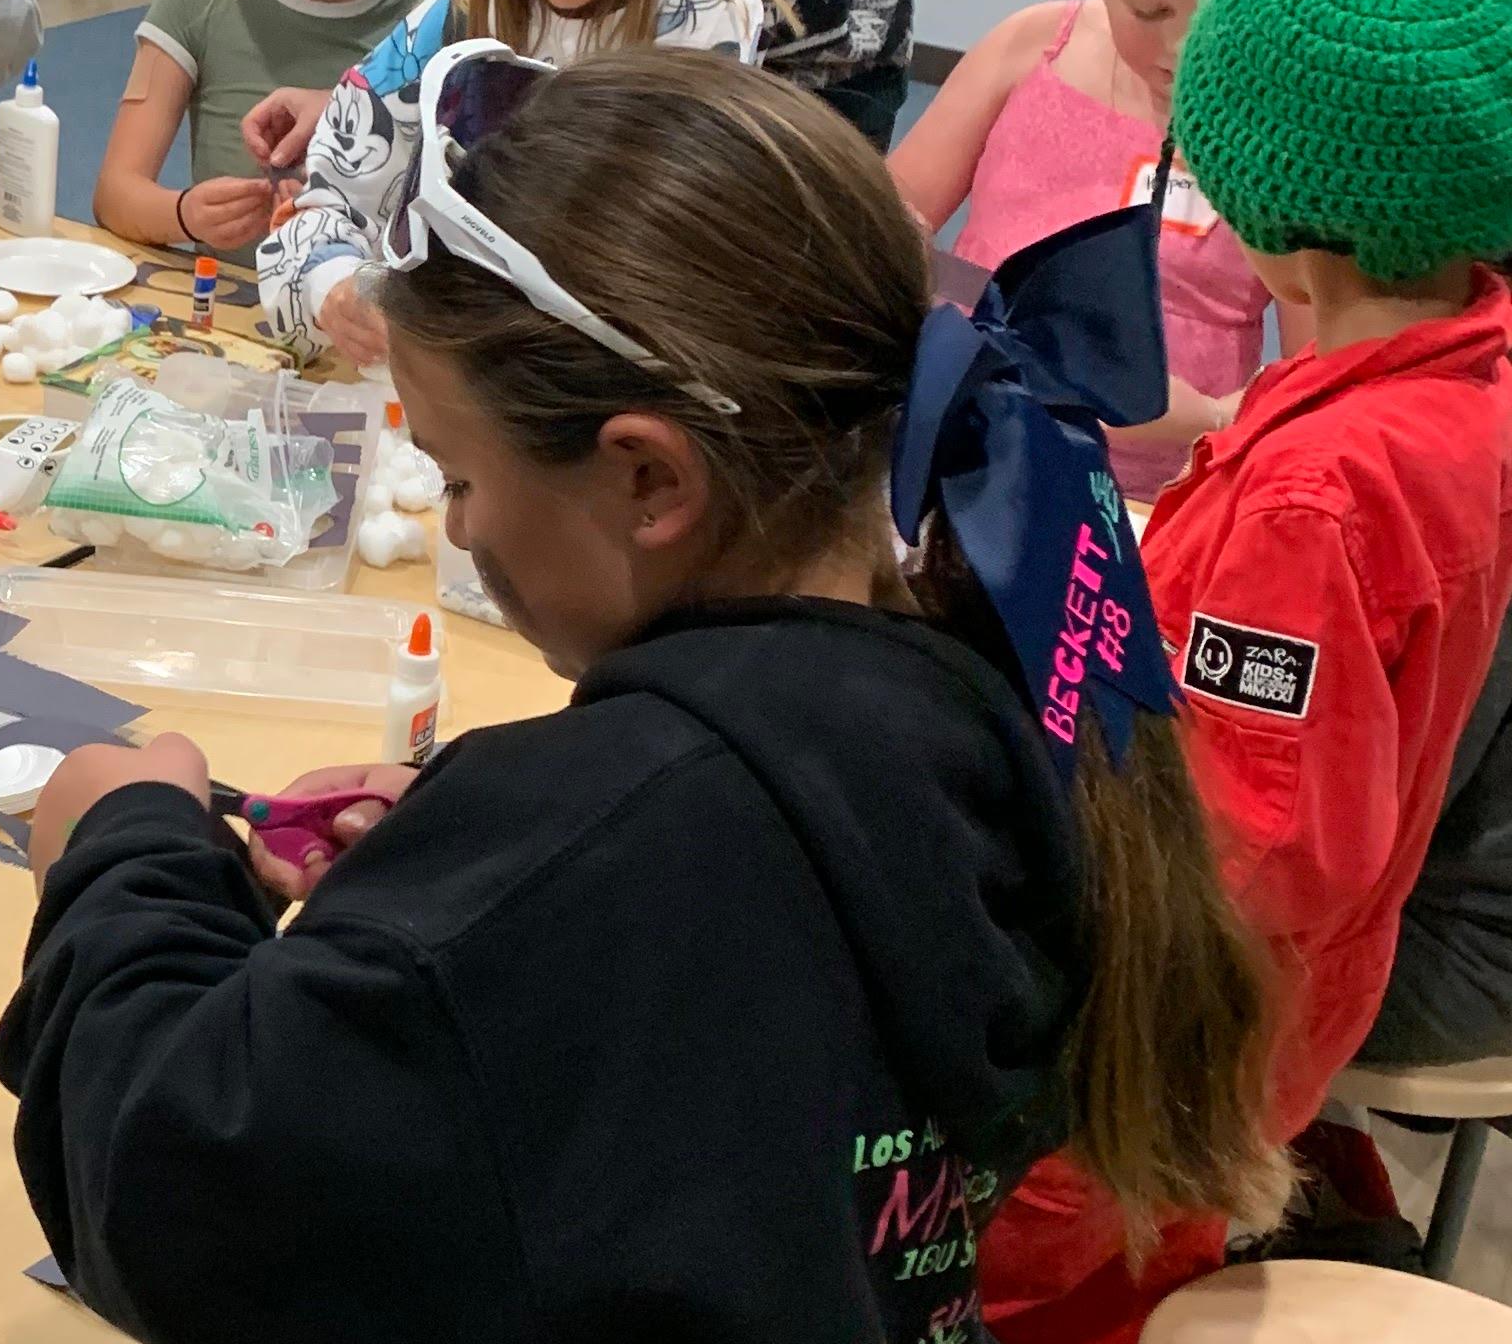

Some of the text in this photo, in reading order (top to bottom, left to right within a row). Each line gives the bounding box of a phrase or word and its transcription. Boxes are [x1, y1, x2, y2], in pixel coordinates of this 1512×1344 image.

[1043, 522, 1109, 744] BECKETT
[1096, 597, 1132, 673] #8
[853, 1129, 914, 1174] LOS
